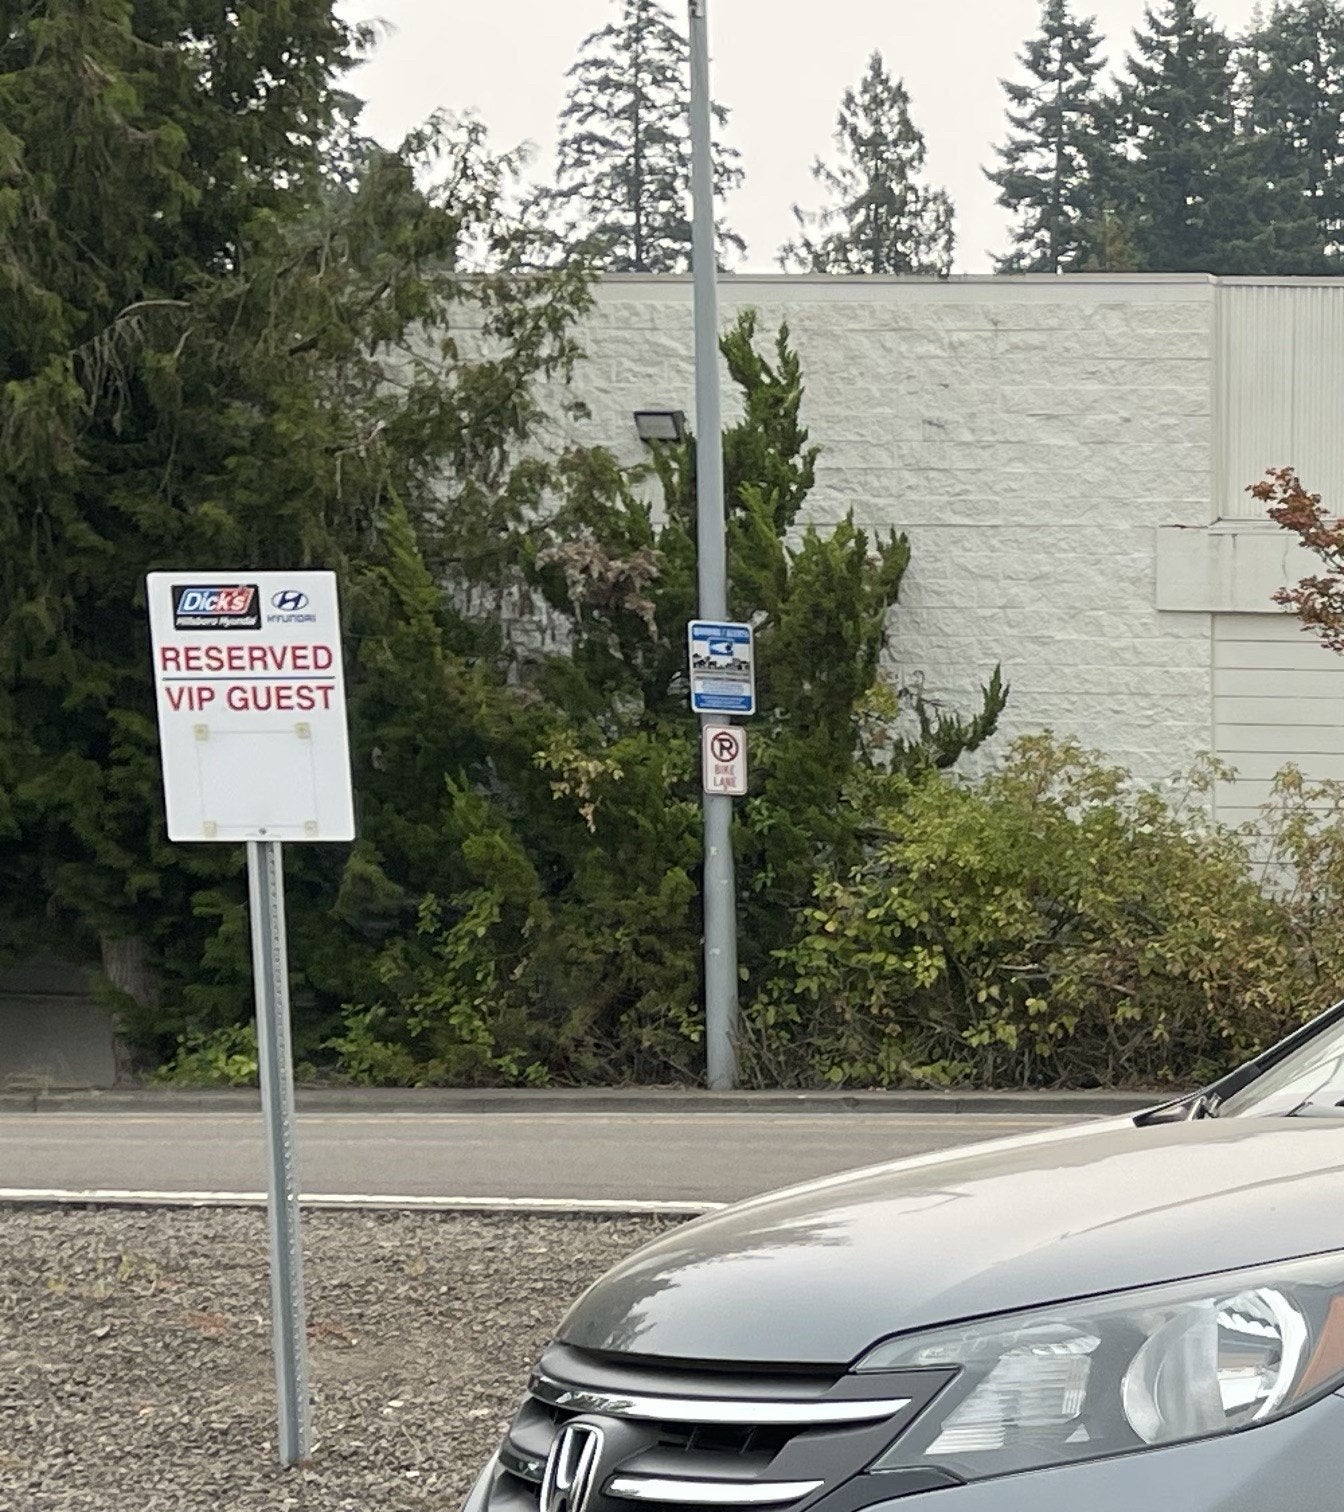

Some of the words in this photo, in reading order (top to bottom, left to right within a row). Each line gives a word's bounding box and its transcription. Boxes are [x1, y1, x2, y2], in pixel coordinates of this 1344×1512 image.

[183, 590, 247, 612] Dick's
[267, 614, 316, 623] HYUNDAI
[161, 645, 333, 671] RESERVED
[165, 687, 216, 712] VIP
[227, 685, 335, 711] GUEST
